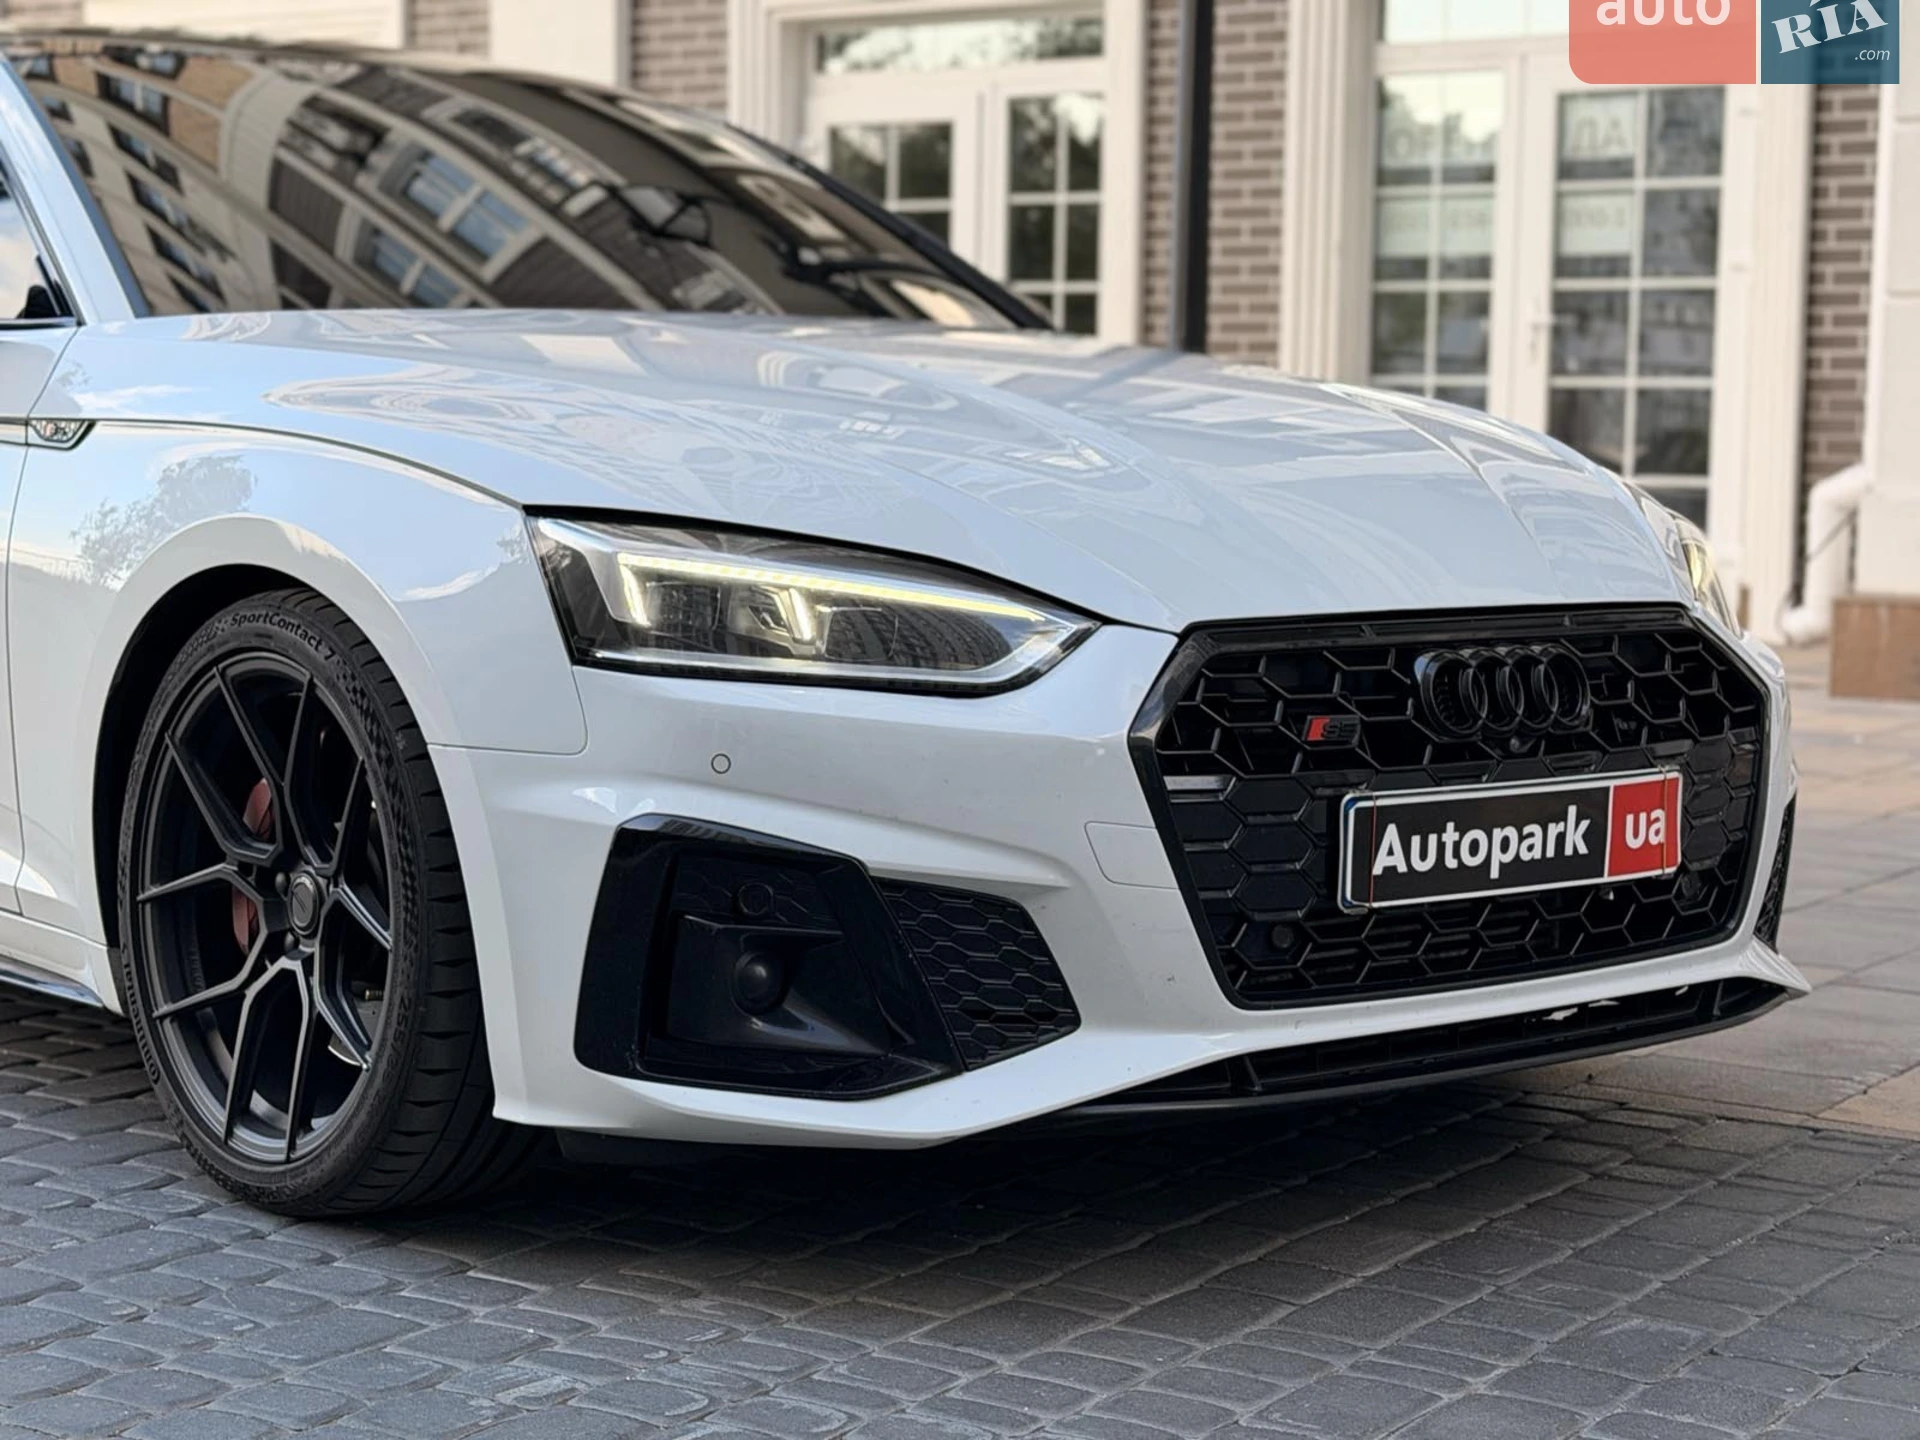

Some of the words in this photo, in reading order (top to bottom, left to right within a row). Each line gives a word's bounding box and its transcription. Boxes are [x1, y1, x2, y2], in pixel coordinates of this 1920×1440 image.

[230, 611, 323, 652] SportContact
[324, 647, 336, 660] 7
[1372, 804, 1591, 879] Autopark
[1625, 808, 1665, 850] ua
[123, 962, 161, 1085] Continental
